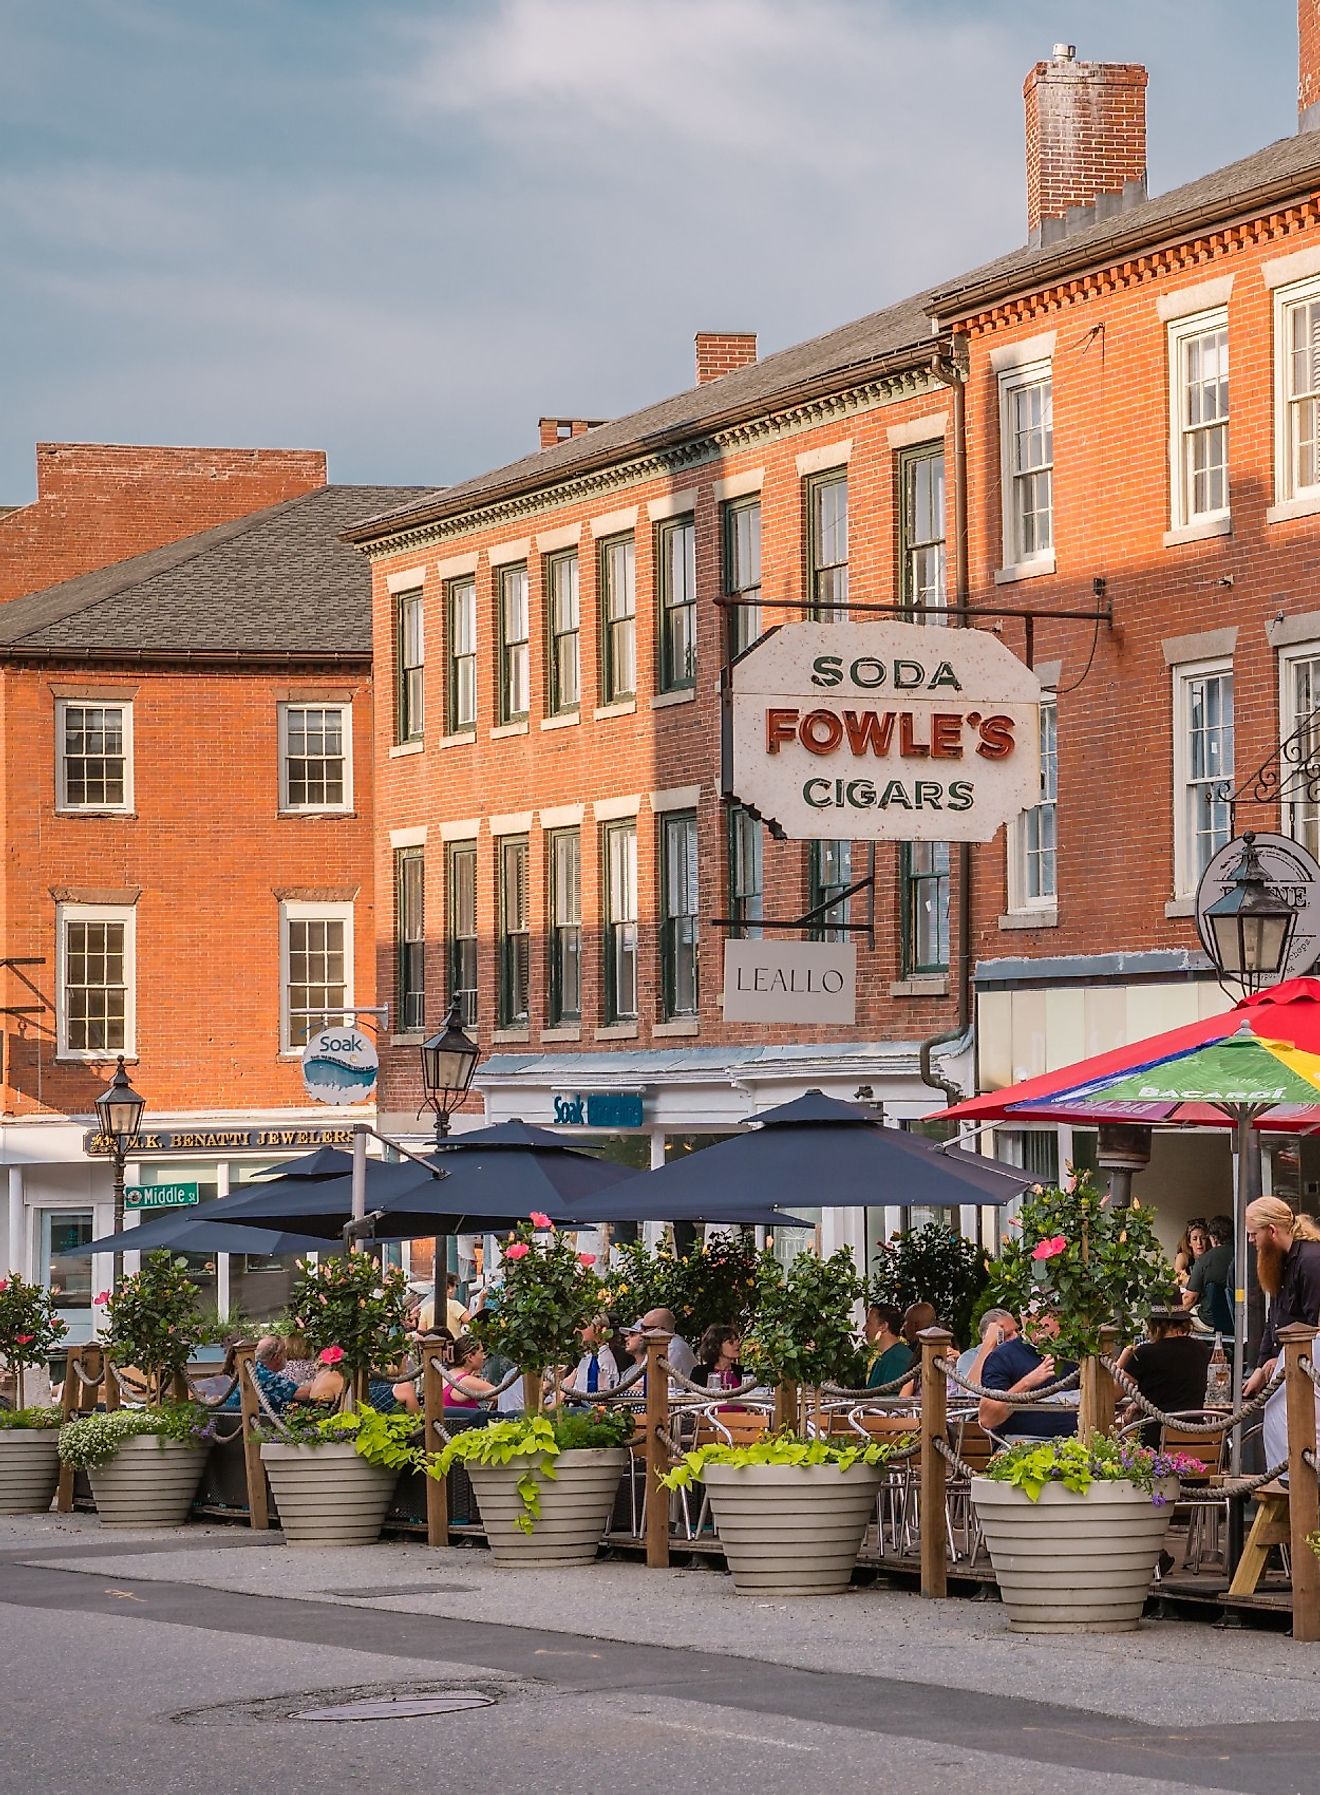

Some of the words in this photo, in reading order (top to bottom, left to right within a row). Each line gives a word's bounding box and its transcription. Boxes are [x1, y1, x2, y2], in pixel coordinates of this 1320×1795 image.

[811, 656, 962, 691] SODA
[766, 708, 1015, 760] FOWLE'S
[803, 778, 974, 811] CIGARS
[737, 968, 844, 993] LEALLO
[320, 1034, 362, 1052] Soak
[554, 1095, 585, 1125] Soak
[169, 1131, 252, 1147] BENATTI
[144, 1186, 185, 1204] Middle
